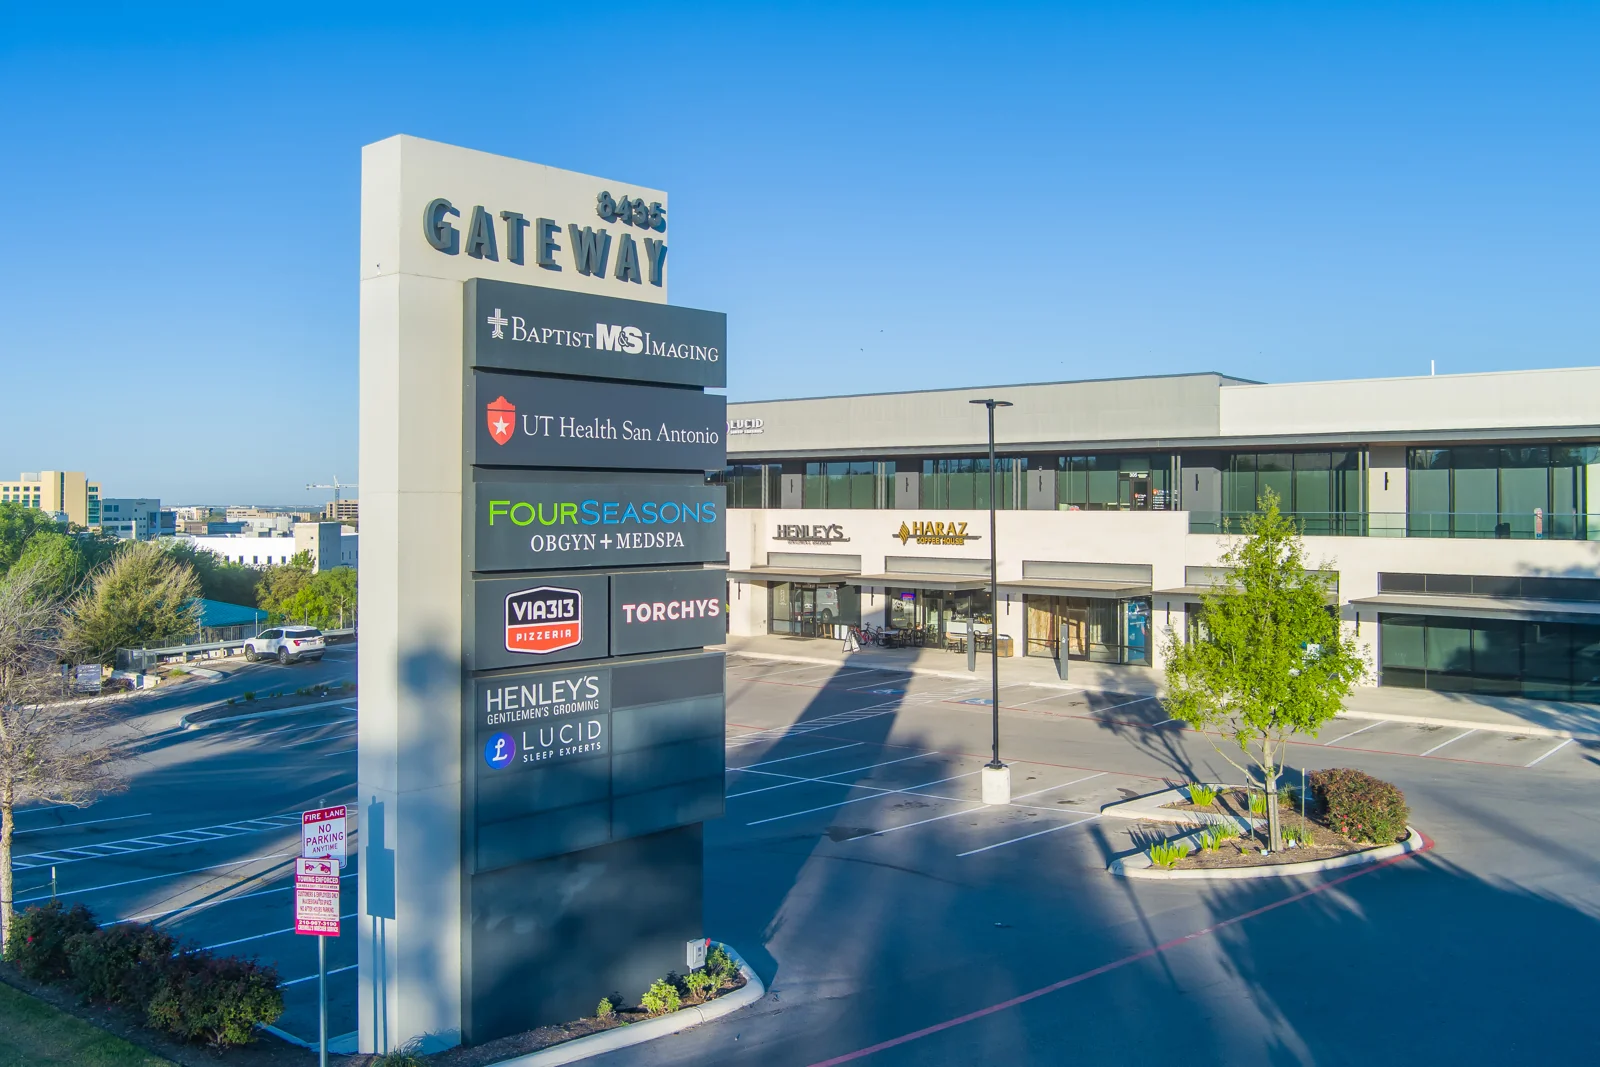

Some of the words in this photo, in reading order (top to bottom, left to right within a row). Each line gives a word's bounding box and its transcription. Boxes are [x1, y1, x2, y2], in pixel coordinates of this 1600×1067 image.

[596, 190, 667, 233] 8435
[423, 197, 668, 287] GATEWAY
[511, 316, 593, 349] BAPTIST
[595, 323, 643, 355] M&S
[644, 332, 719, 363] IMAGING
[522, 414, 554, 437] UT
[559, 416, 618, 440] Health
[622, 420, 651, 441] San
[656, 423, 719, 445] Antonio
[730, 418, 764, 429] LUCID
[777, 523, 844, 539] HENLEY'S
[912, 521, 968, 537] HARAZ
[530, 533, 595, 553] OBGYN
[616, 531, 685, 549] MEDSPA
[916, 537, 941, 545] COFFEE
[942, 537, 964, 546] HOUSE
[622, 598, 720, 624] TORCHYS
[516, 628, 573, 643] PIZZERIA
[486, 675, 600, 713] HENLEY'S
[487, 706, 549, 725] GENTLEMEN'S
[553, 699, 599, 716] GROOMING
[522, 720, 602, 751] LUCID
[523, 750, 554, 763] SLEEP
[559, 741, 602, 757] EXPERTS
[304, 812, 321, 822] FIRE
[324, 808, 345, 819] LANE
[318, 823, 332, 834] NO
[306, 831, 344, 847] PARKING
[312, 843, 338, 854] ANYTIME
[297, 875, 315, 883] TOWING
[315, 876, 339, 885] ENFORCED
